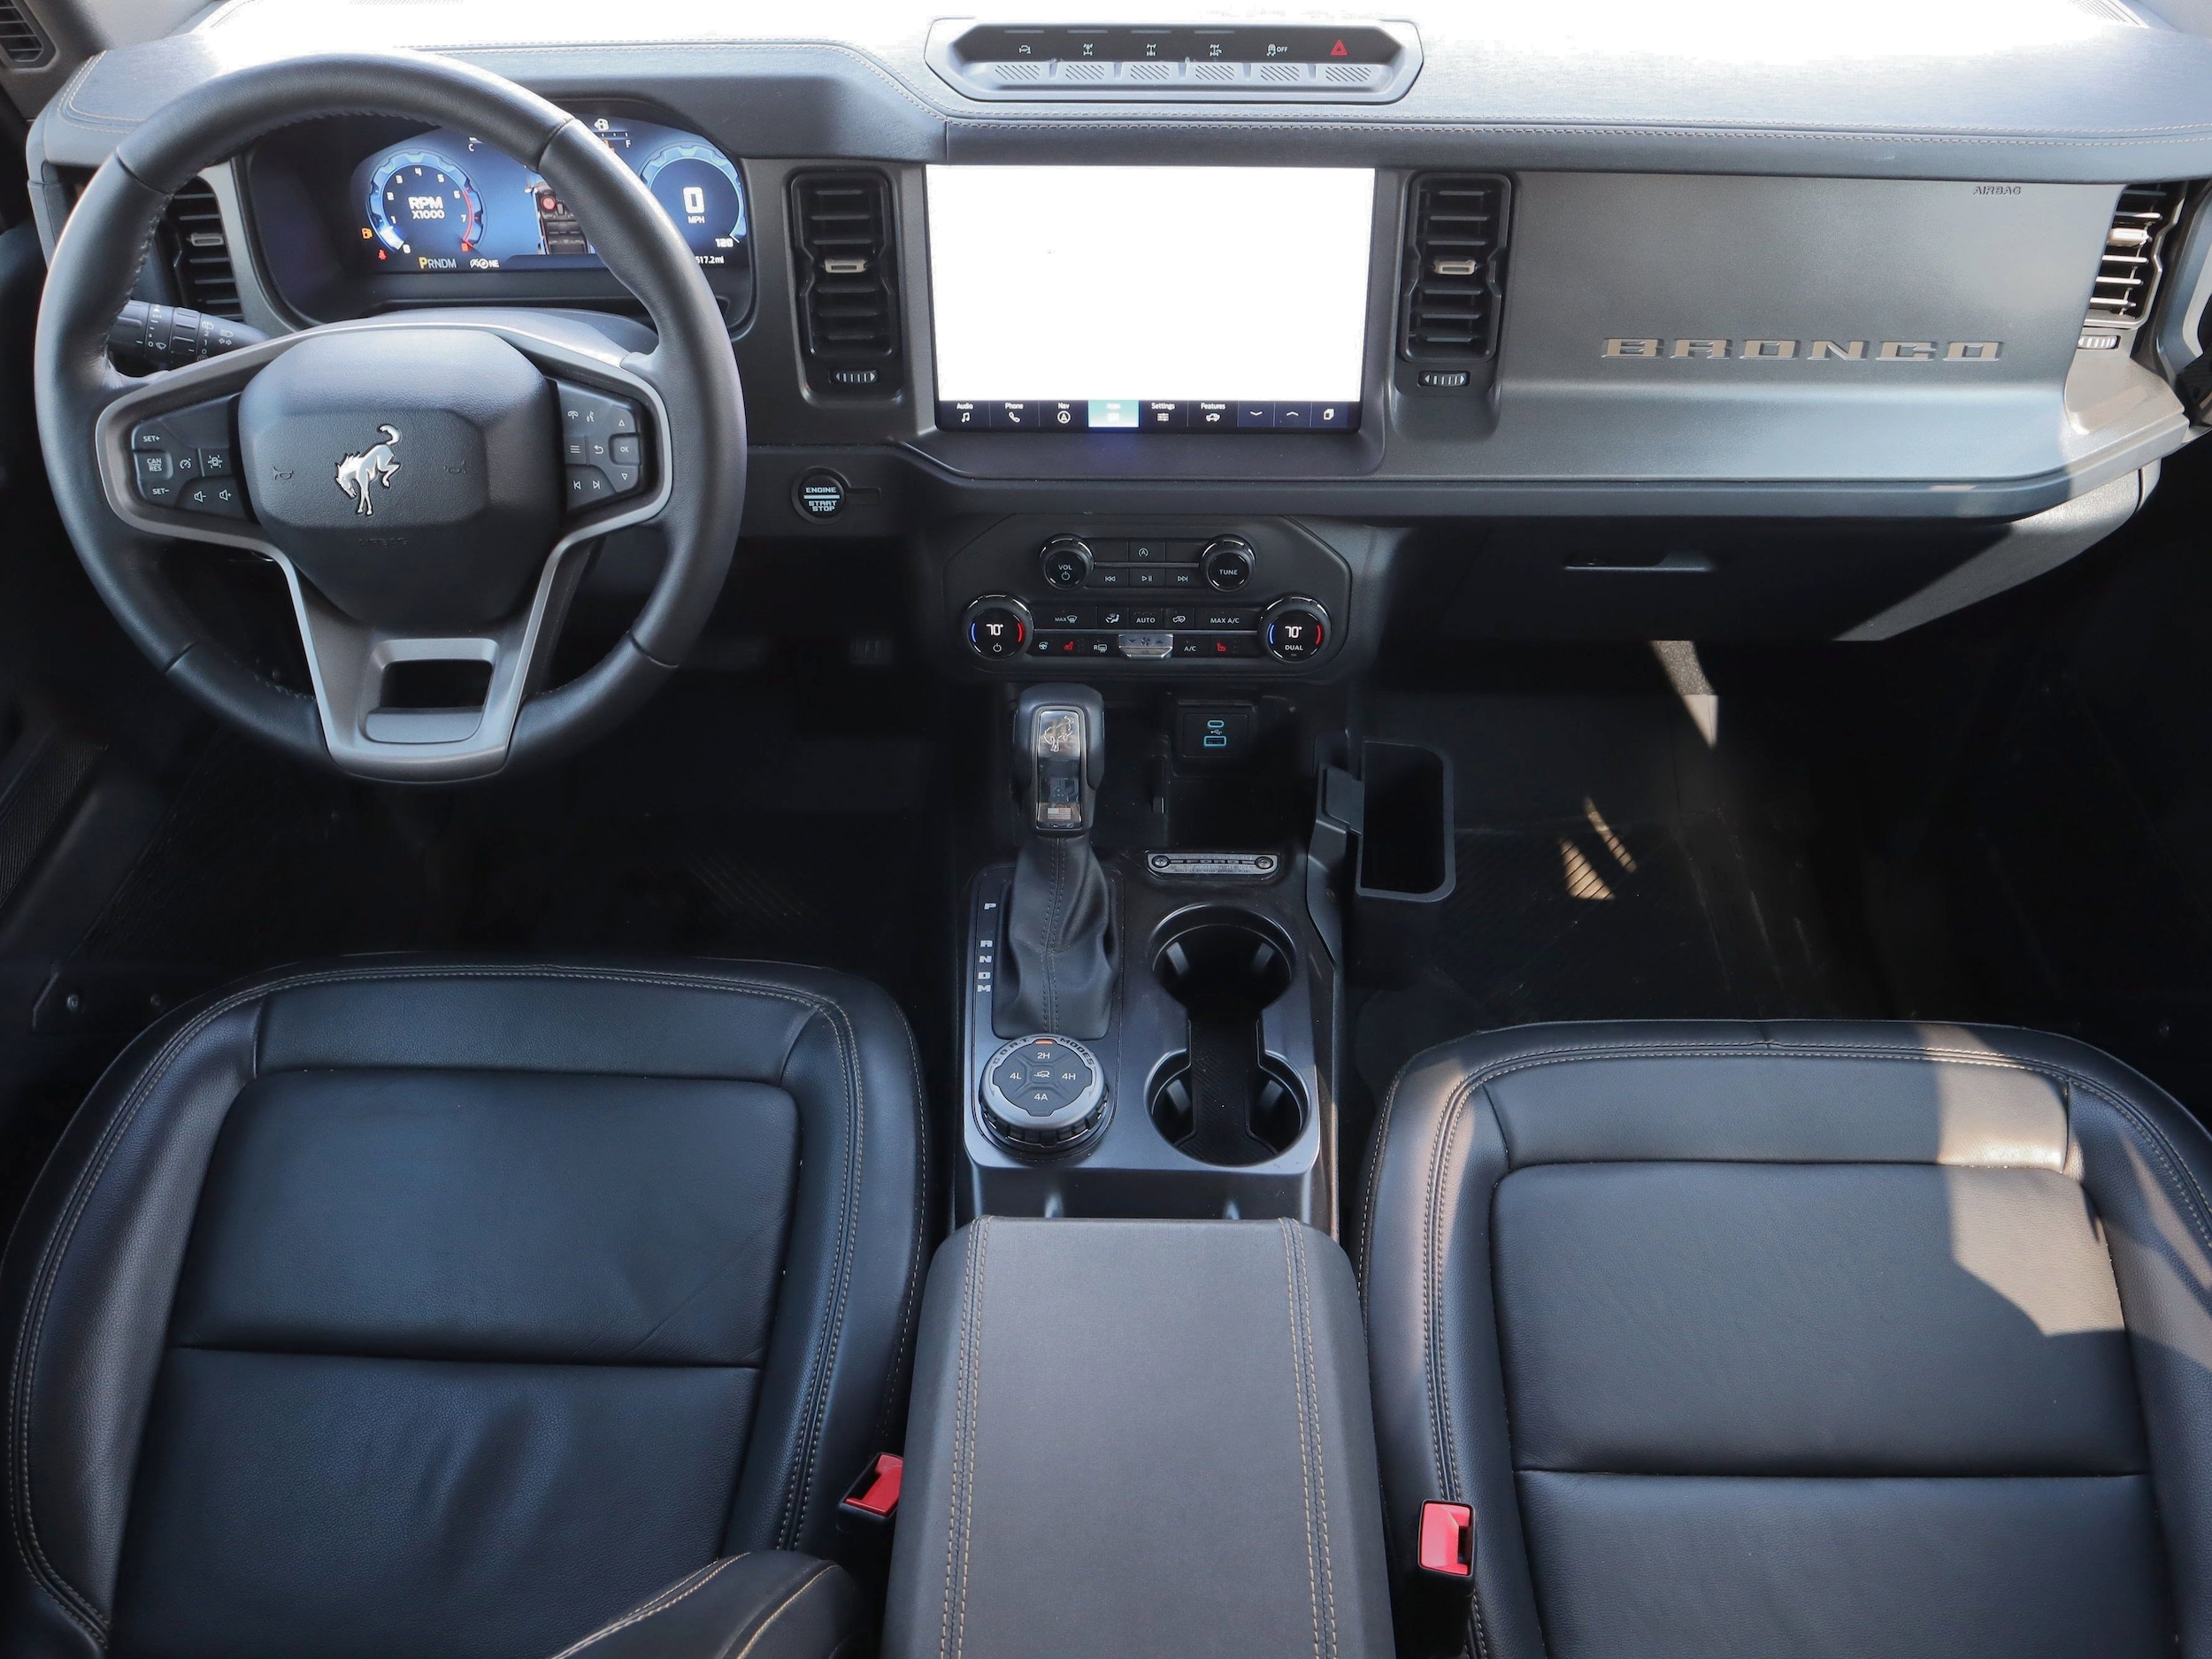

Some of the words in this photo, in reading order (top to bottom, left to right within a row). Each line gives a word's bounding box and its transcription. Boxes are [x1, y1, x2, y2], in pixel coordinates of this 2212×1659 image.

[468, 143, 475, 152] C
[415, 167, 422, 176] 4
[396, 174, 403, 184] 3
[437, 173, 445, 183] 5
[453, 190, 461, 199] 6
[1973, 186, 2022, 196] AIRBAG
[387, 191, 395, 201] 2
[682, 187, 705, 214] 0
[407, 196, 444, 211] RPM
[411, 209, 445, 219] X1000
[461, 214, 467, 223] 7
[391, 215, 397, 224] 1
[687, 215, 705, 224] MPH
[715, 237, 733, 248] 120
[1601, 337, 2005, 362] BRONCO
[1151, 402, 1176, 411] Settings
[979, 955, 992, 964] N
[1060, 1037, 1095, 1065] MODES
[1010, 1071, 1022, 1080] 4L
[1033, 1093, 1048, 1102] 4A
